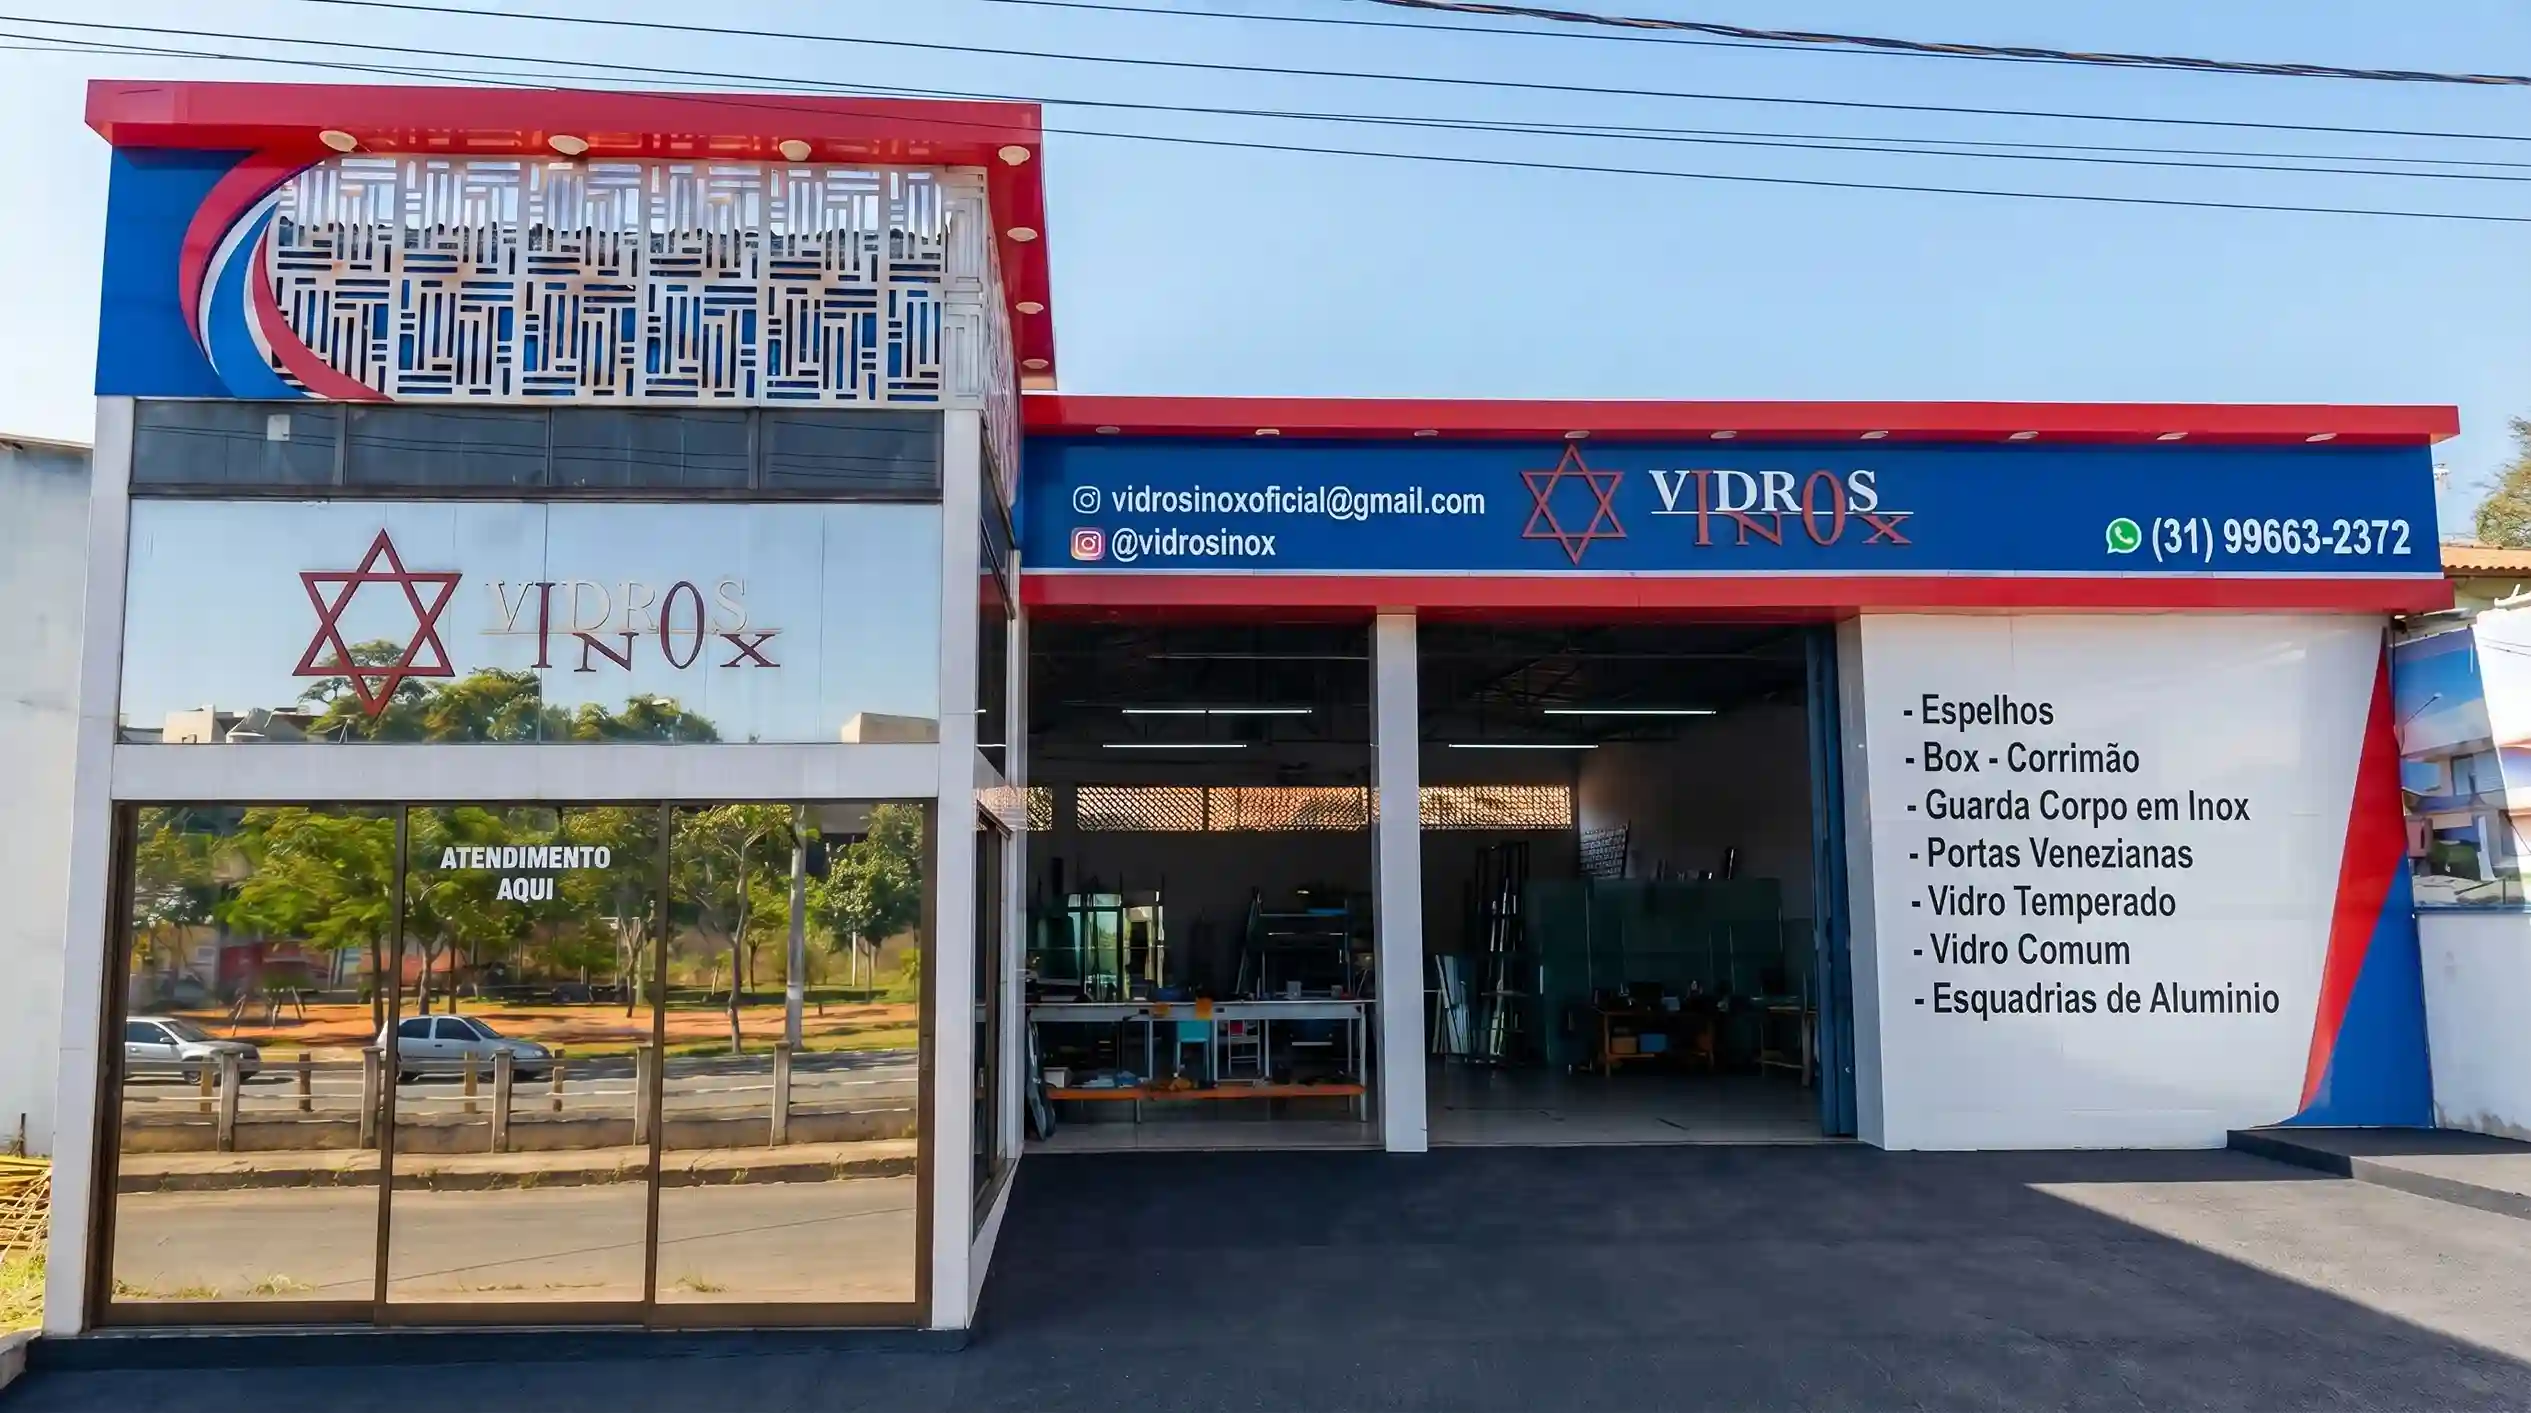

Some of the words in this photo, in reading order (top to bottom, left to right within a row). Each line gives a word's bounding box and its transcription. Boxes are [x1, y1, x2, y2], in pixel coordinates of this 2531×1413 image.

[1111, 484, 1486, 521] vidrosinoxoficial@gmail.com
[1648, 469, 1879, 512] VIDROS
[1690, 470, 1912, 546] INOX
[1111, 527, 1276, 563] @vidrosinox
[2151, 517, 2214, 563] (31)
[2223, 518, 2411, 555] 99663-2372
[484, 579, 749, 631] VIDROS
[530, 580, 781, 672] INOX
[1922, 693, 2054, 731] Espelhos
[1923, 741, 1980, 773] Box
[2007, 741, 2140, 774] Corrimão
[1925, 788, 2030, 821] Guarda
[2039, 789, 2128, 828] Corpo
[2136, 797, 2179, 821] em
[2189, 789, 2251, 821] Inox
[440, 846, 611, 869] ATENDIMENTO
[1927, 836, 2021, 869] Portas
[2028, 836, 2194, 869] Venezianas
[496, 876, 553, 904] AQUI
[1927, 884, 2006, 917] Vidro
[2013, 885, 2176, 925] Temperado
[1929, 932, 2009, 965] Vidro
[2018, 932, 2130, 965] Comum
[1933, 981, 2097, 1022] Esquadrias
[2106, 982, 2141, 1014] de
[2149, 981, 2280, 1014] Aluminio
